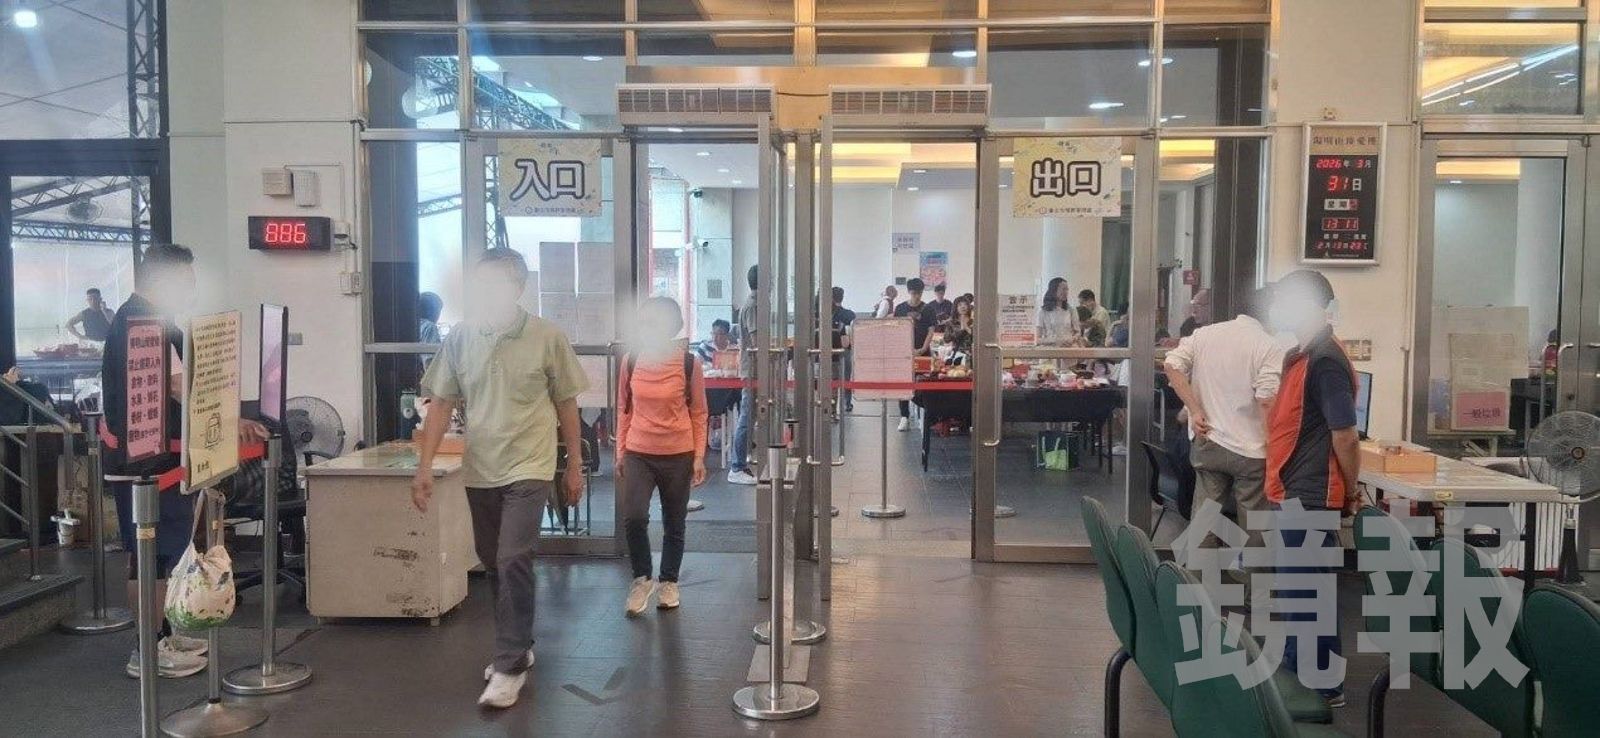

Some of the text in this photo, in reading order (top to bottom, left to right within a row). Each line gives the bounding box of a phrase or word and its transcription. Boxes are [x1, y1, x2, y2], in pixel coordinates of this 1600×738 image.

[509, 158, 585, 201] 入口
[1030, 157, 1101, 198] 出口
[265, 223, 306, 244] 886
